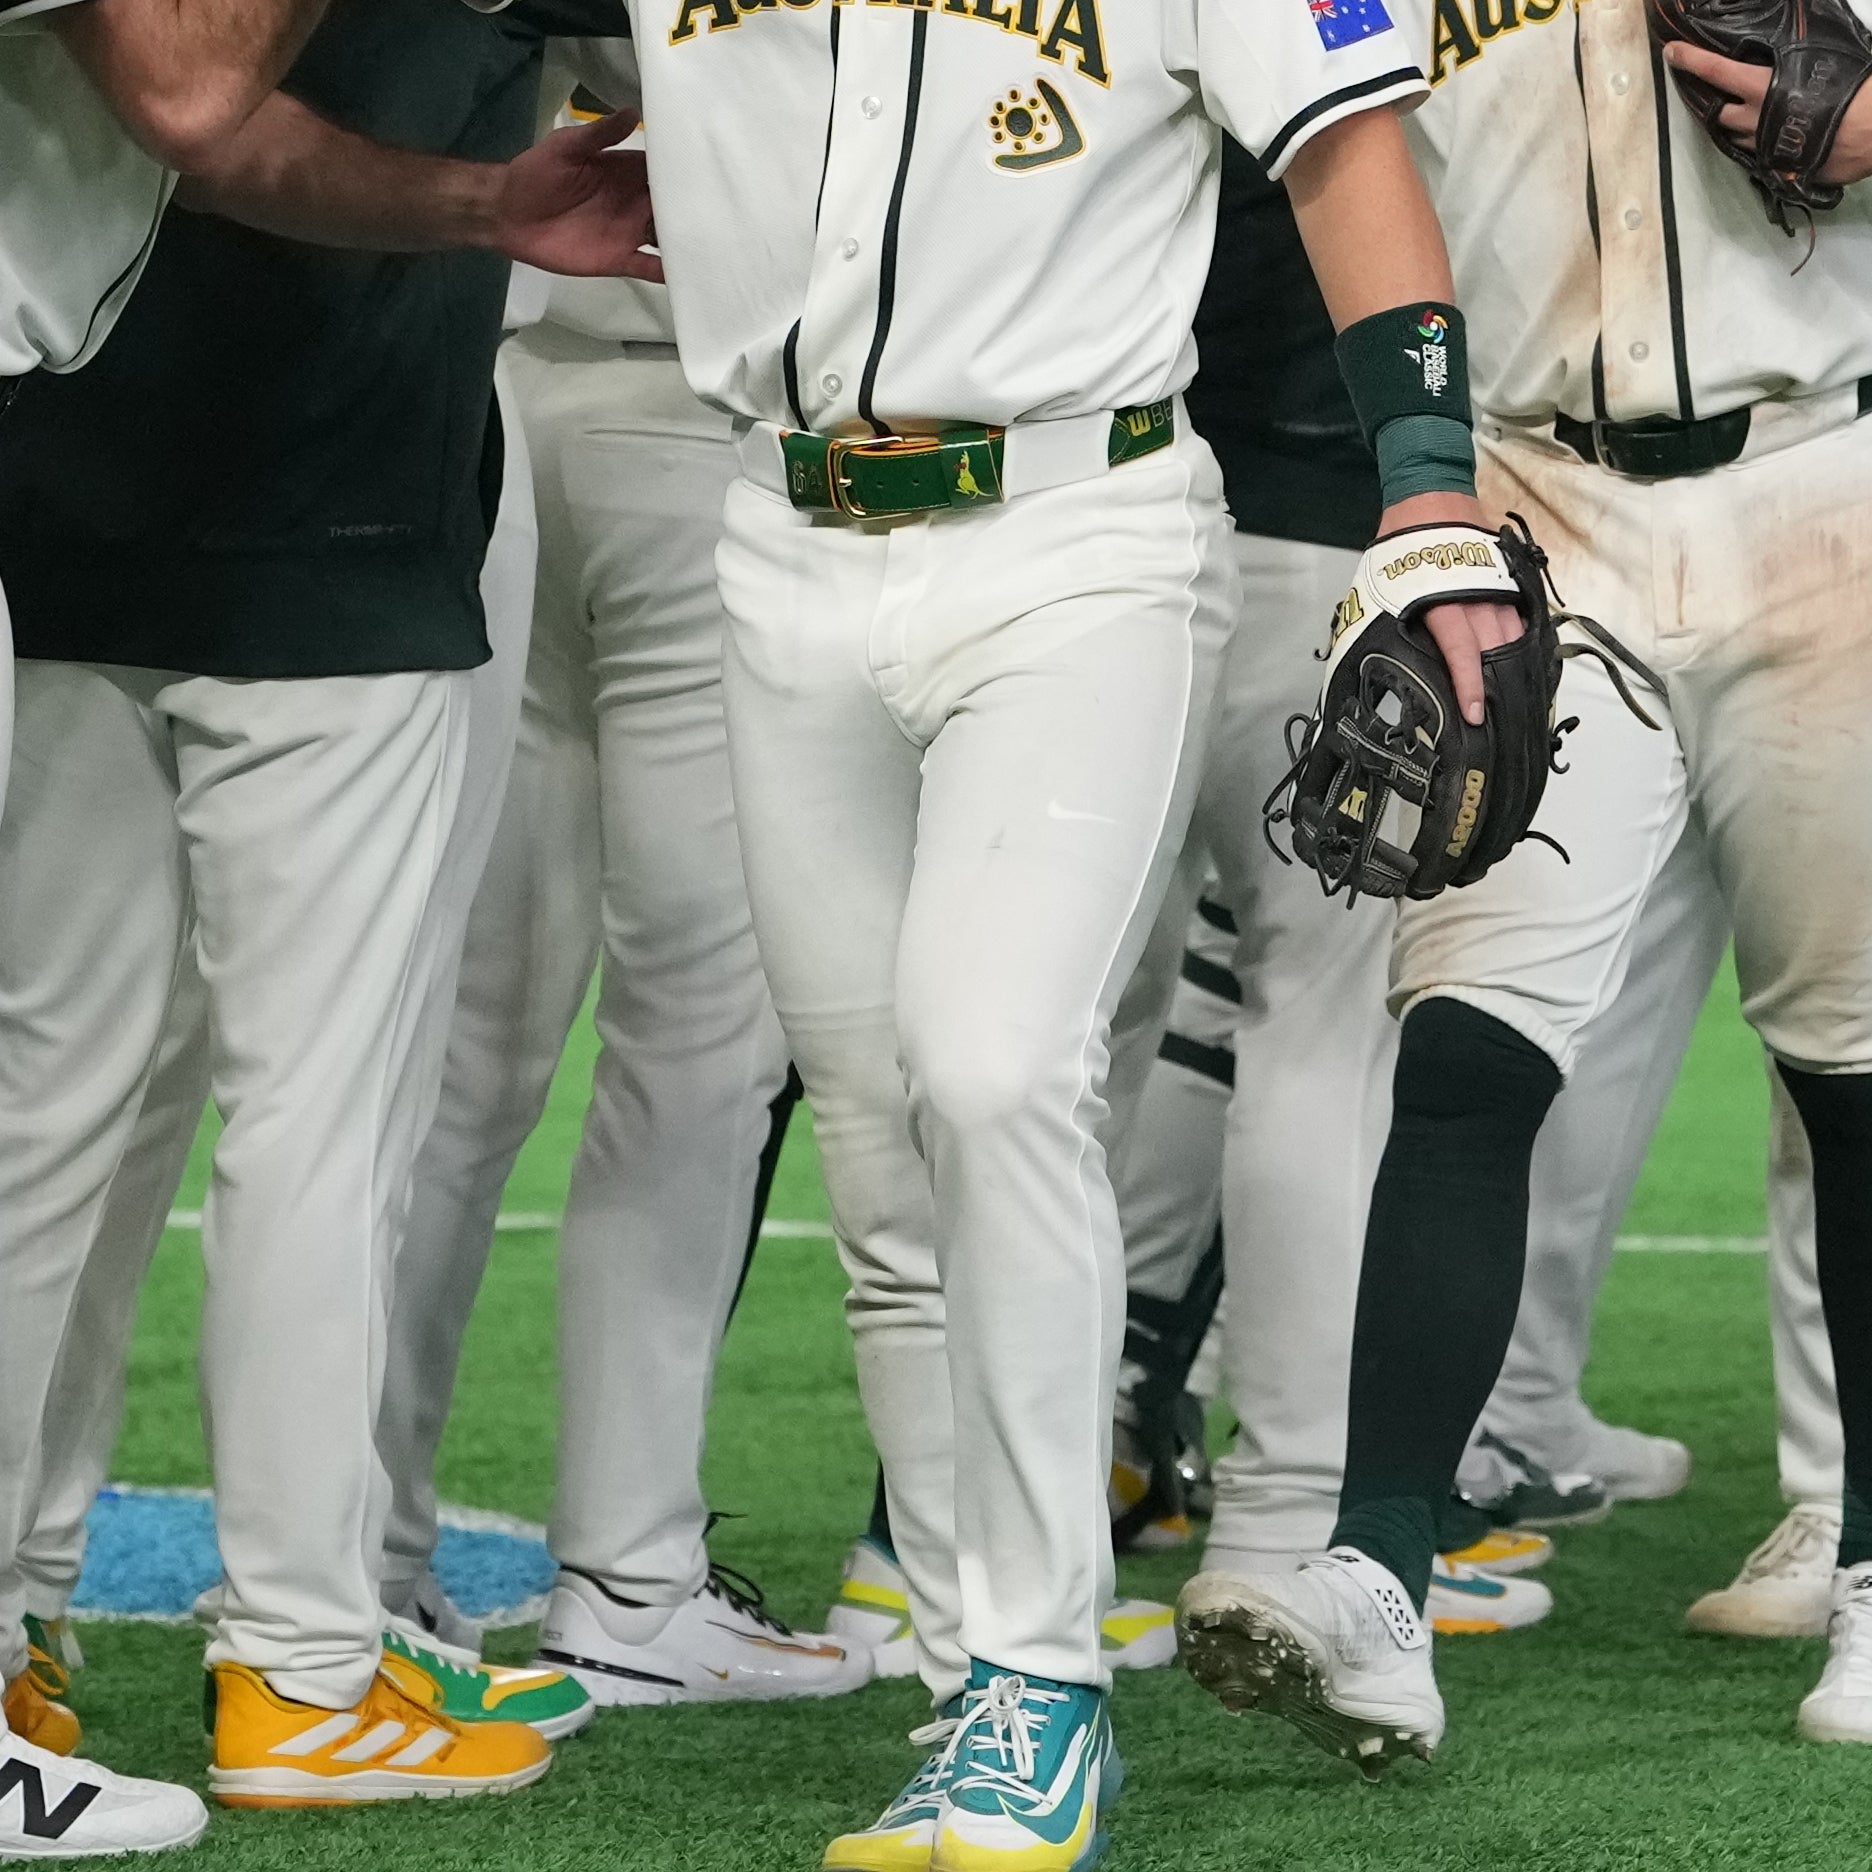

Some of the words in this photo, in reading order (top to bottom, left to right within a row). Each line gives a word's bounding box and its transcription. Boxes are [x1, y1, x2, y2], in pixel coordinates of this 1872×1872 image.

[1422, 343, 1433, 390] CLASSIC
[1438, 345, 1448, 387] WORLD
[1384, 541, 1497, 581] Wilson
[1446, 768, 1486, 858] A2000
